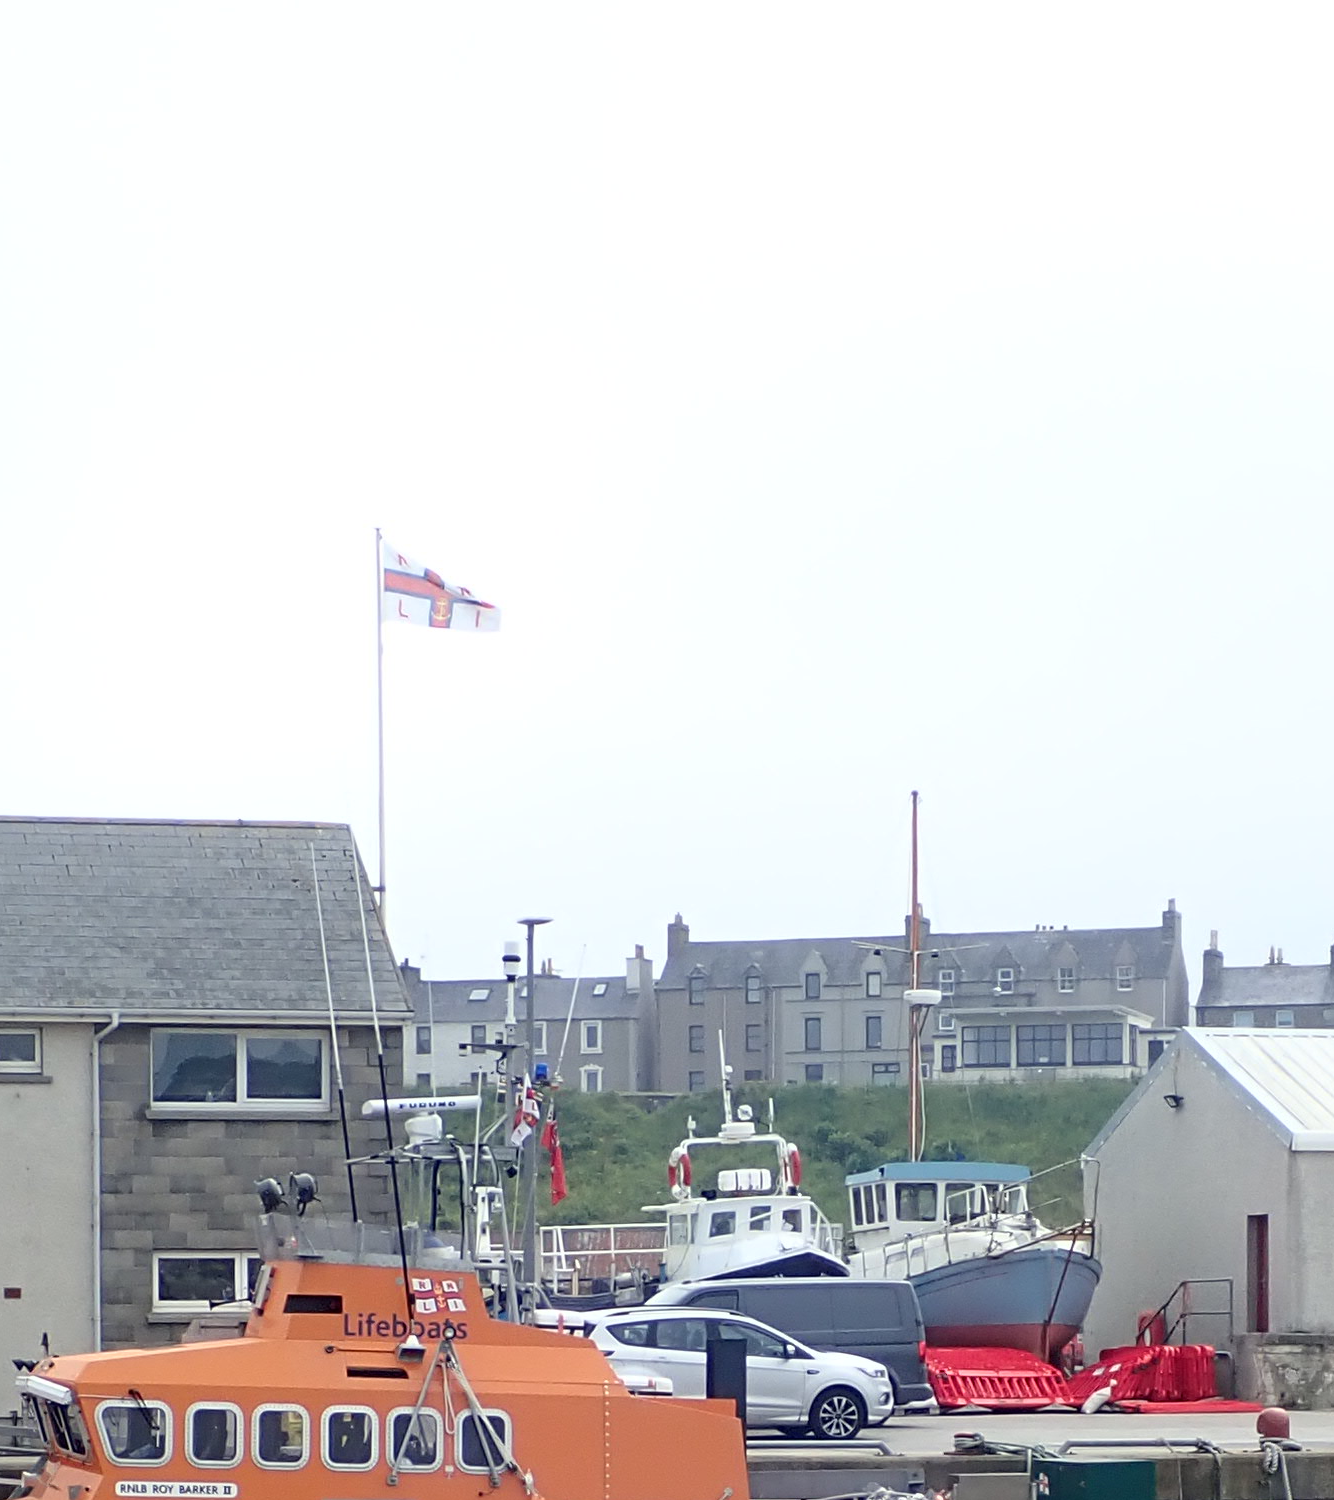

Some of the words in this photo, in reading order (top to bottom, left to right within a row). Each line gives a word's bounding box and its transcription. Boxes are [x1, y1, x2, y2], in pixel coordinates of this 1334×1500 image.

[120, 1484, 147, 1494] RNLB
[152, 1484, 174, 1494] ROY
[179, 1485, 219, 1495] BARKER
